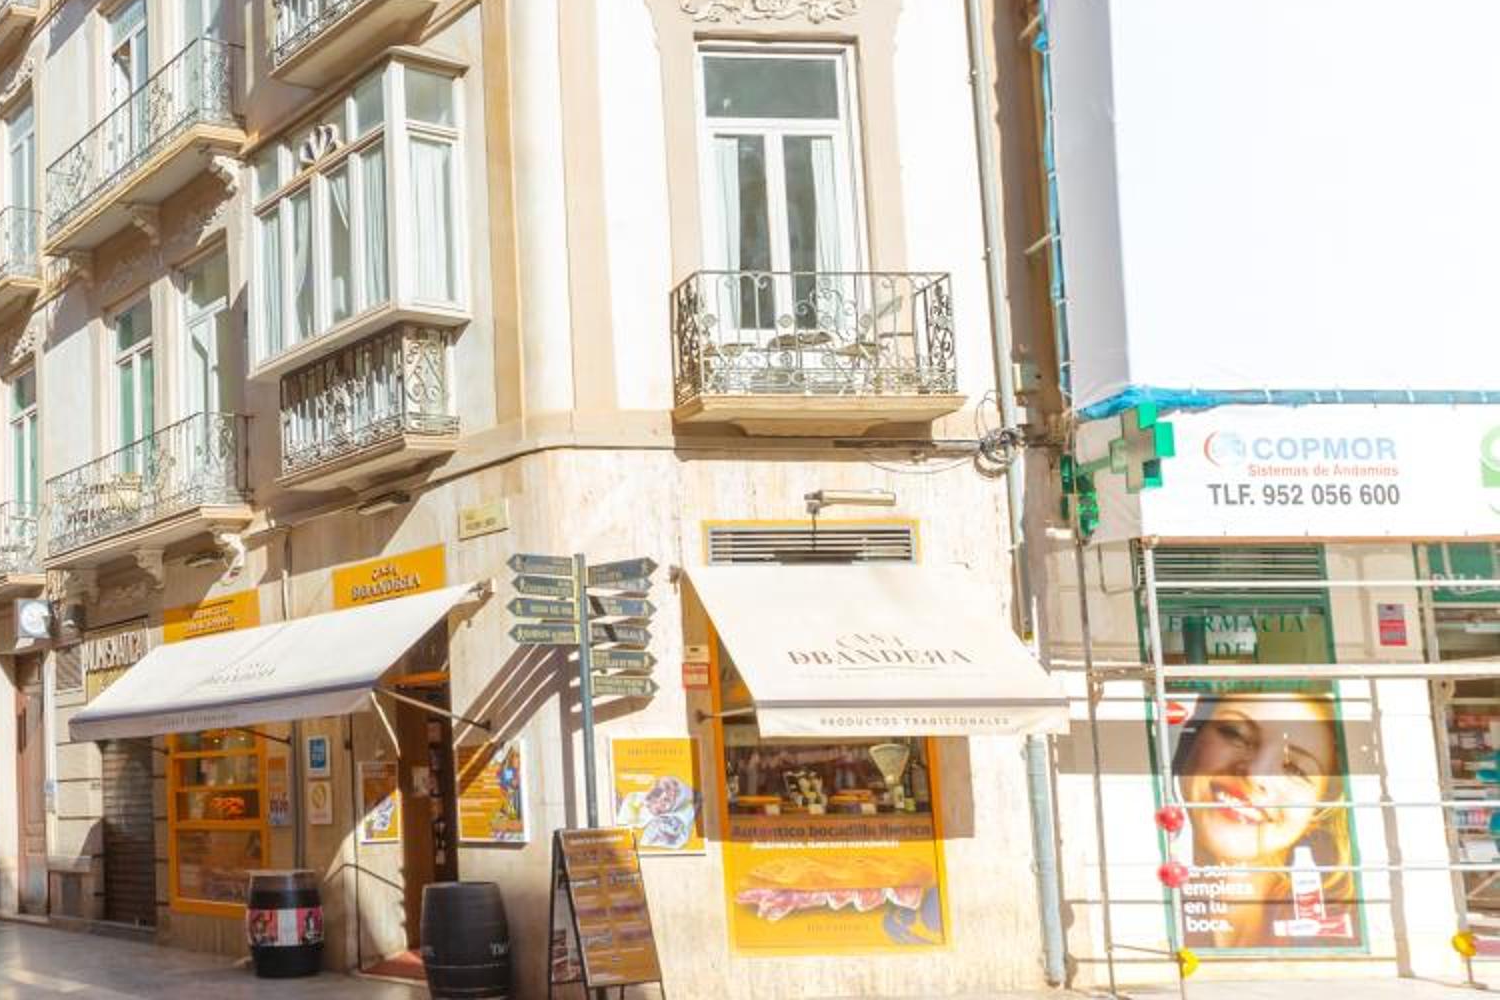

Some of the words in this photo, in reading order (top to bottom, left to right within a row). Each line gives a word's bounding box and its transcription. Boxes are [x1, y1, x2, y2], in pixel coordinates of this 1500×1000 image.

[1252, 437, 1397, 461] COPMOR
[1248, 464, 1309, 477] Sistemas
[1313, 464, 1329, 477] de
[1333, 464, 1399, 477] Andamios
[1207, 484, 1255, 505] TLF.
[1263, 484, 1304, 505] 952
[1311, 484, 1352, 505] 056
[1359, 485, 1400, 506] 600
[820, 716, 899, 728] PRODUCTOS
